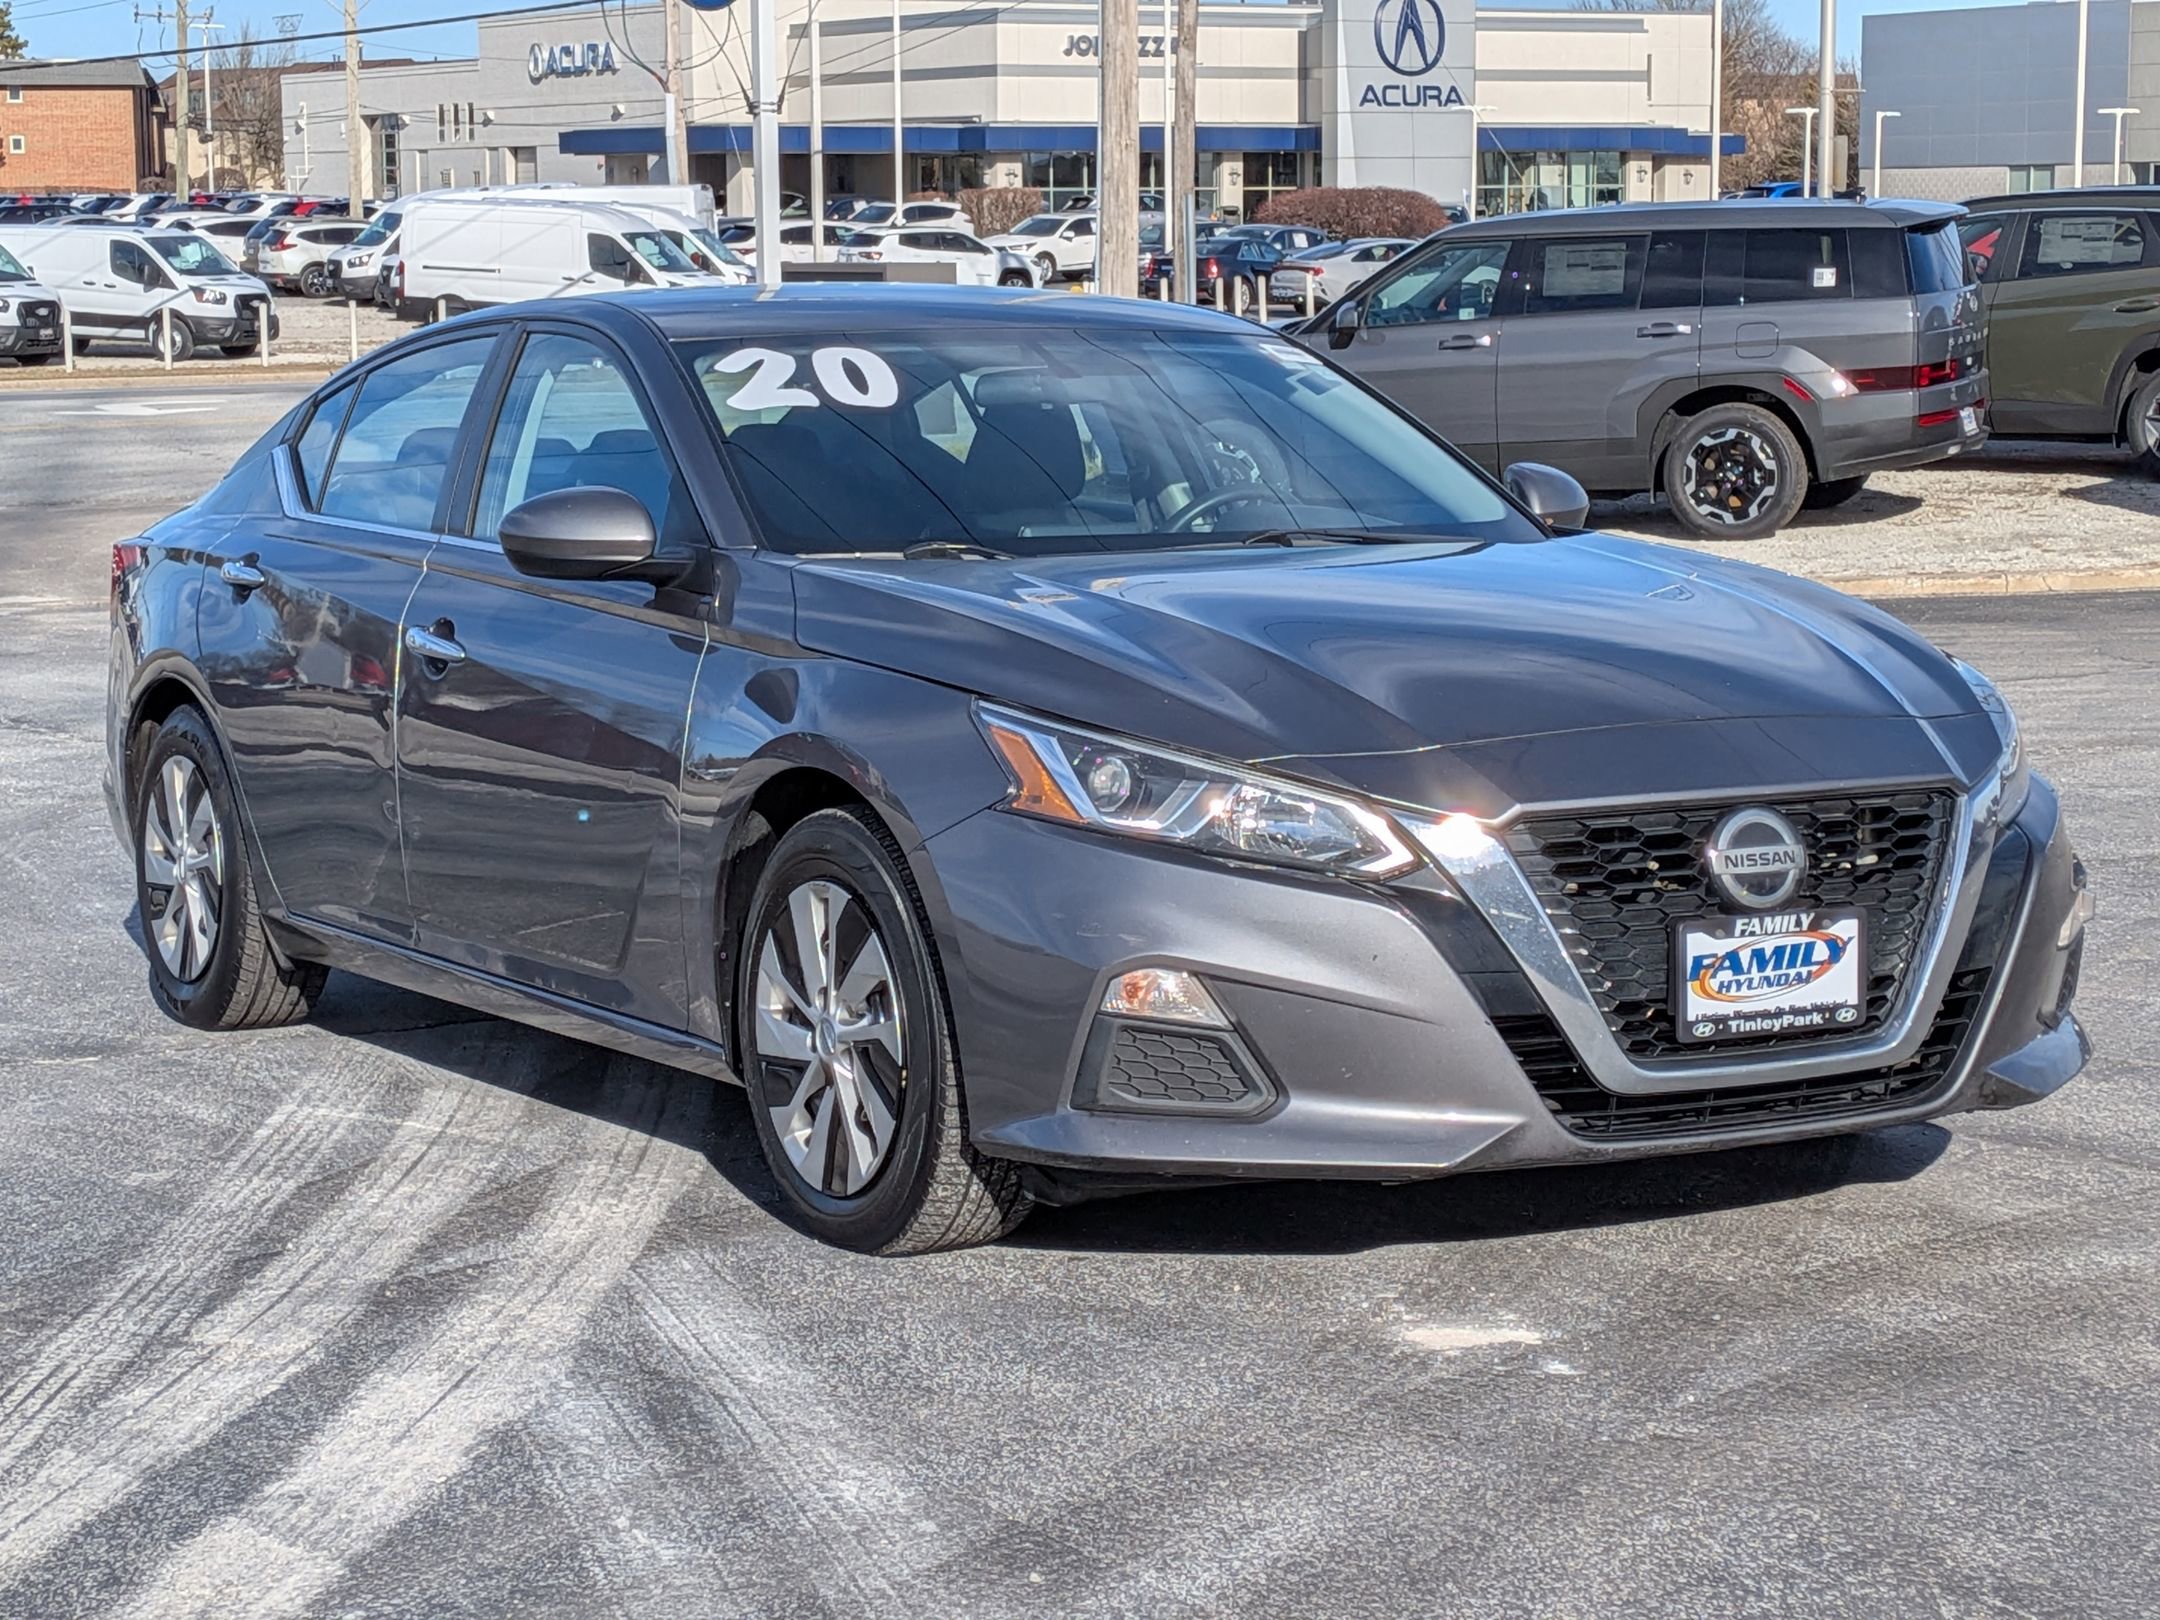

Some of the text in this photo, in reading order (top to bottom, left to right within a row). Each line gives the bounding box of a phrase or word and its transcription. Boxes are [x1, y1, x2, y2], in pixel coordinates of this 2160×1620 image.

[546, 42, 618, 75] ACURA
[1359, 84, 1465, 107] ACURA
[713, 347, 899, 411] 20
[1724, 850, 1796, 869] NISSAN
[1734, 912, 1815, 937] FAMILY
[1687, 936, 1856, 982] FAMILY
[1717, 970, 1814, 994] HYUNDAI
[1728, 1011, 1824, 1033] TinleyPark
